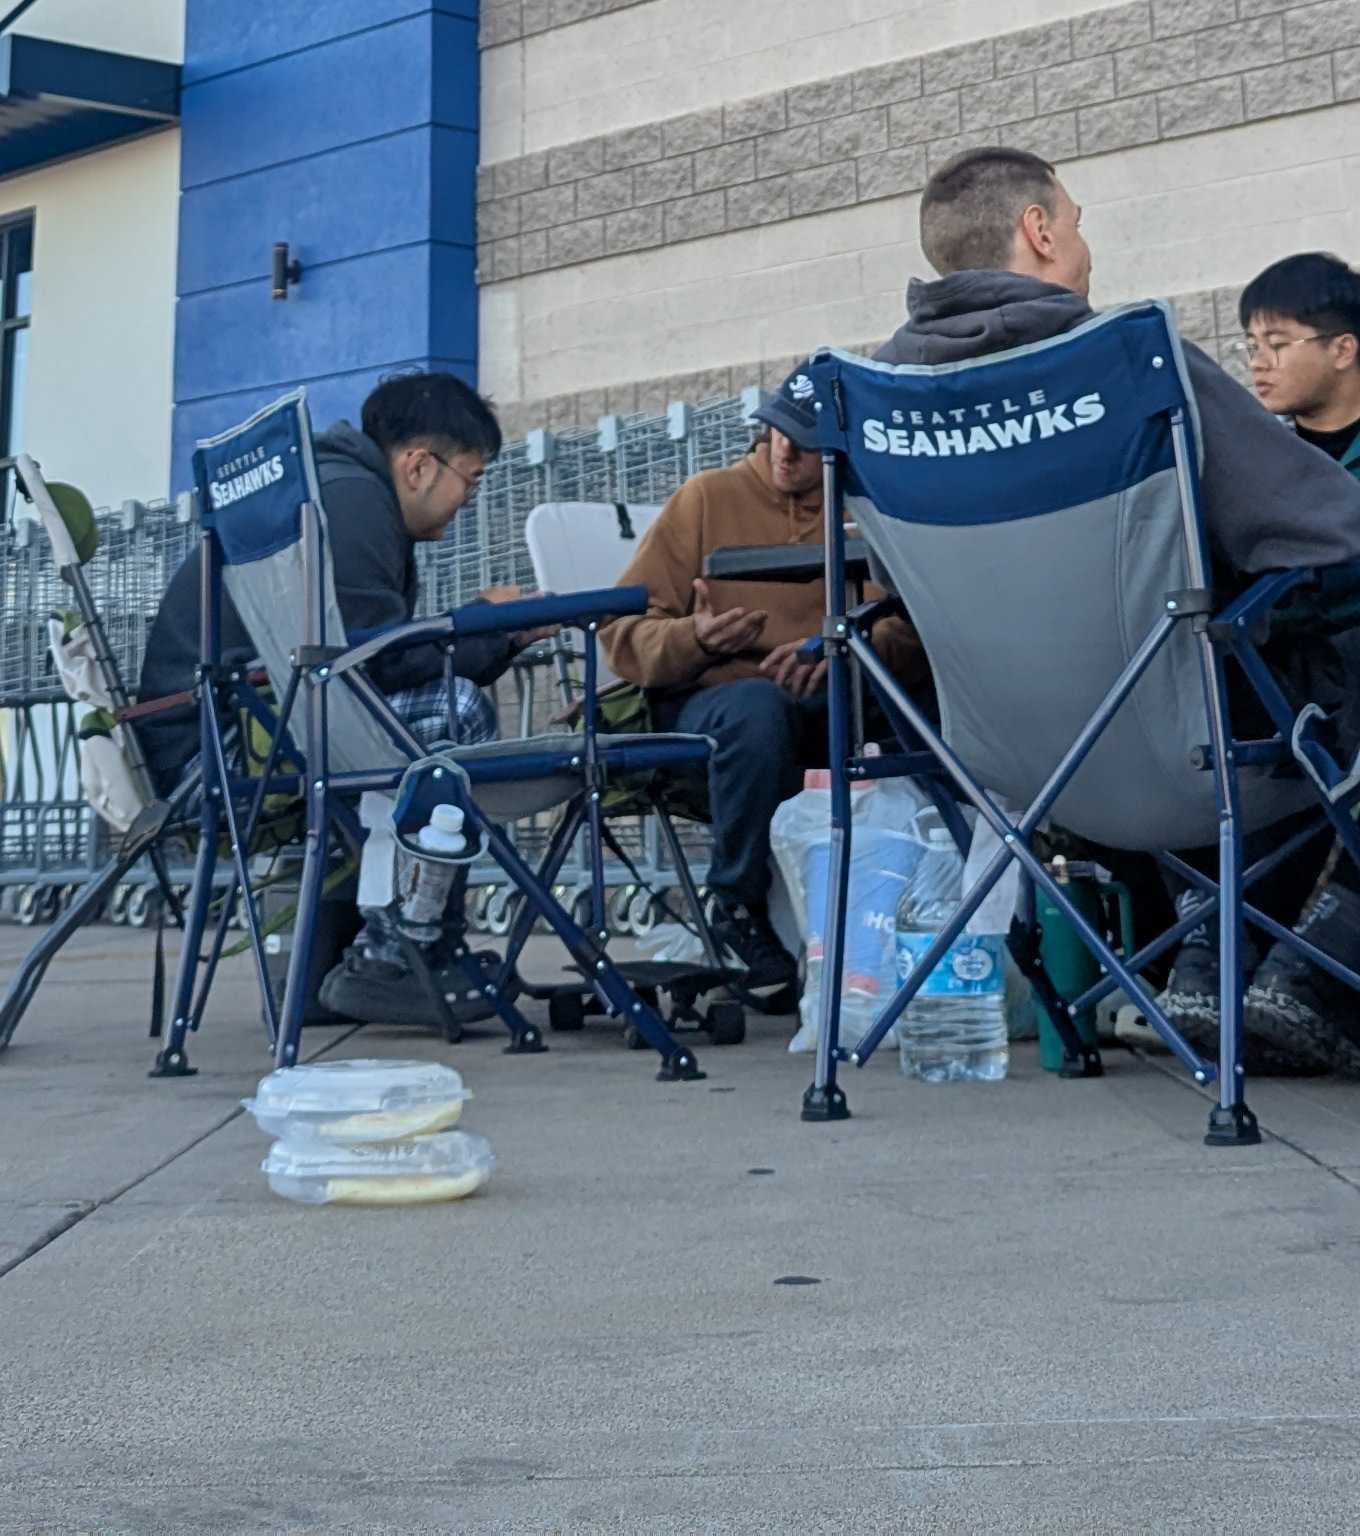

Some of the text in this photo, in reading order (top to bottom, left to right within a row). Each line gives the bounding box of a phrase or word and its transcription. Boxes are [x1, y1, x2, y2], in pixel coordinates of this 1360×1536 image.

[862, 392, 1106, 457] SEAHAWKS
[892, 389, 1045, 425] SEATTLE
[210, 455, 284, 510] SEAHAWKS
[217, 446, 265, 478] SEATTLE
